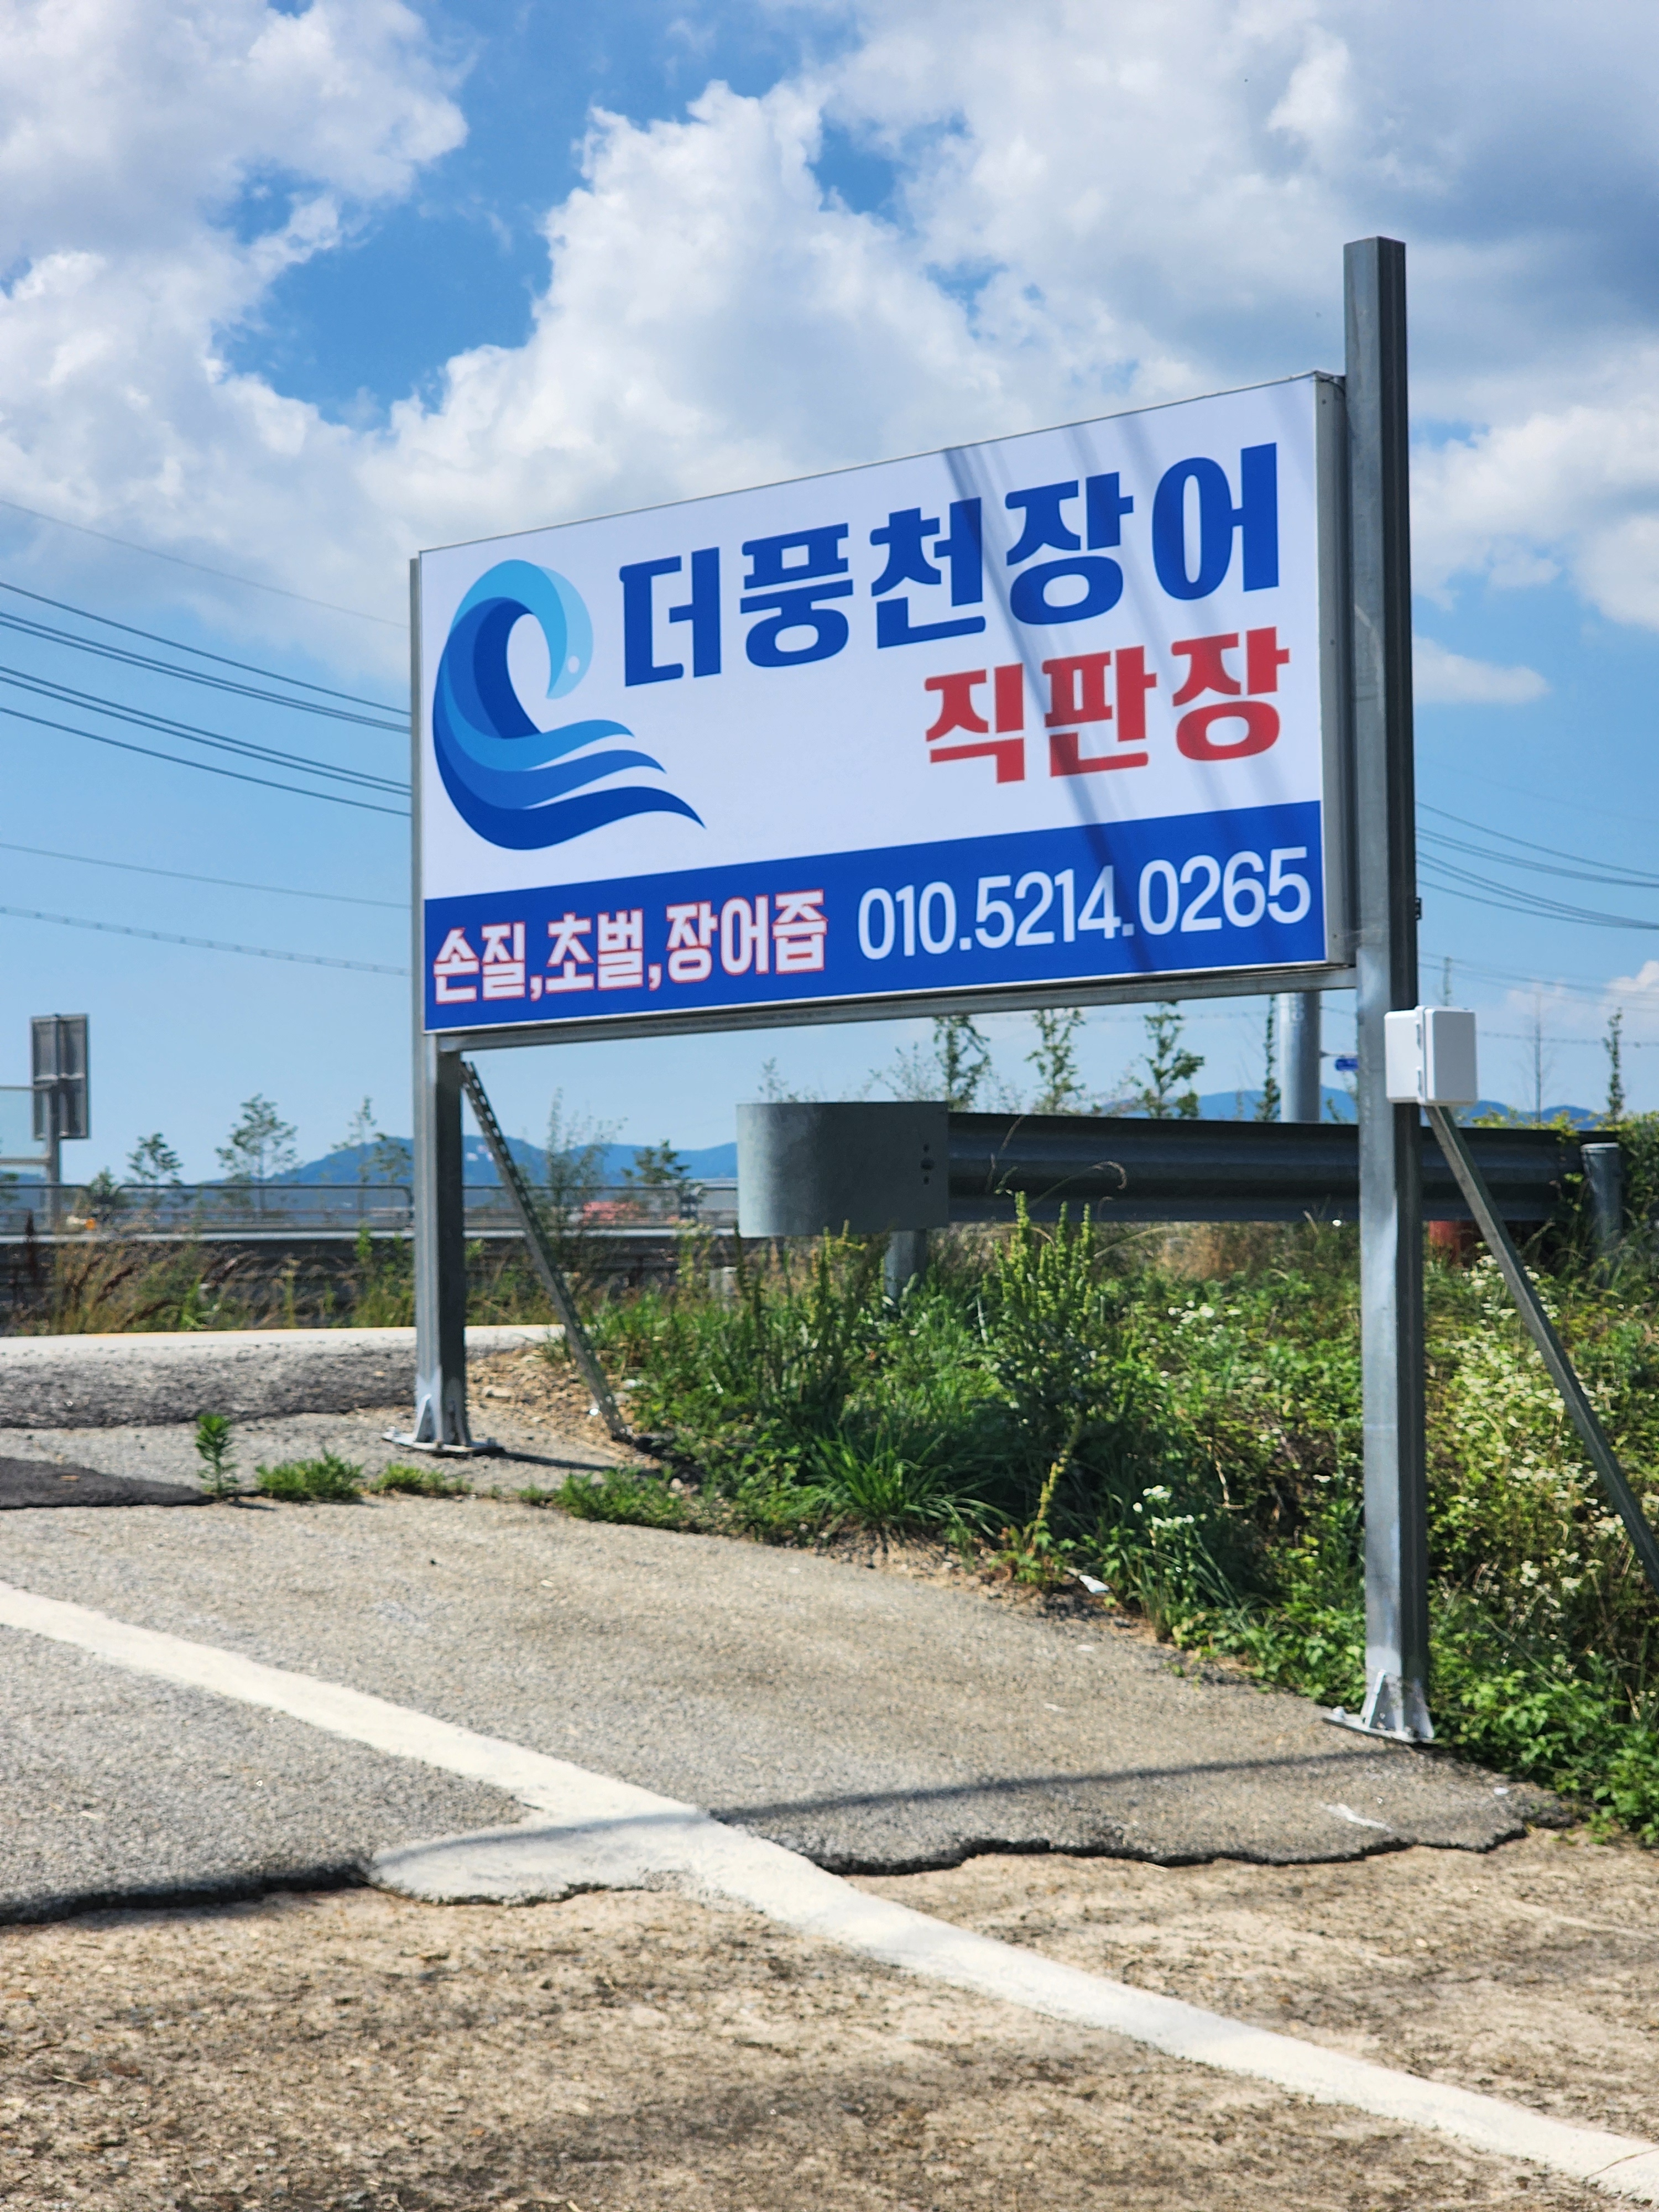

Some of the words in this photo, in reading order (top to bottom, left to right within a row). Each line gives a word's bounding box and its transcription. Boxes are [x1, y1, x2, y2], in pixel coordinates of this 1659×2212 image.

[618, 441, 1280, 688] 더풍천장어
[925, 627, 1290, 783] 직판장
[858, 847, 1311, 960] 010.5214.0265
